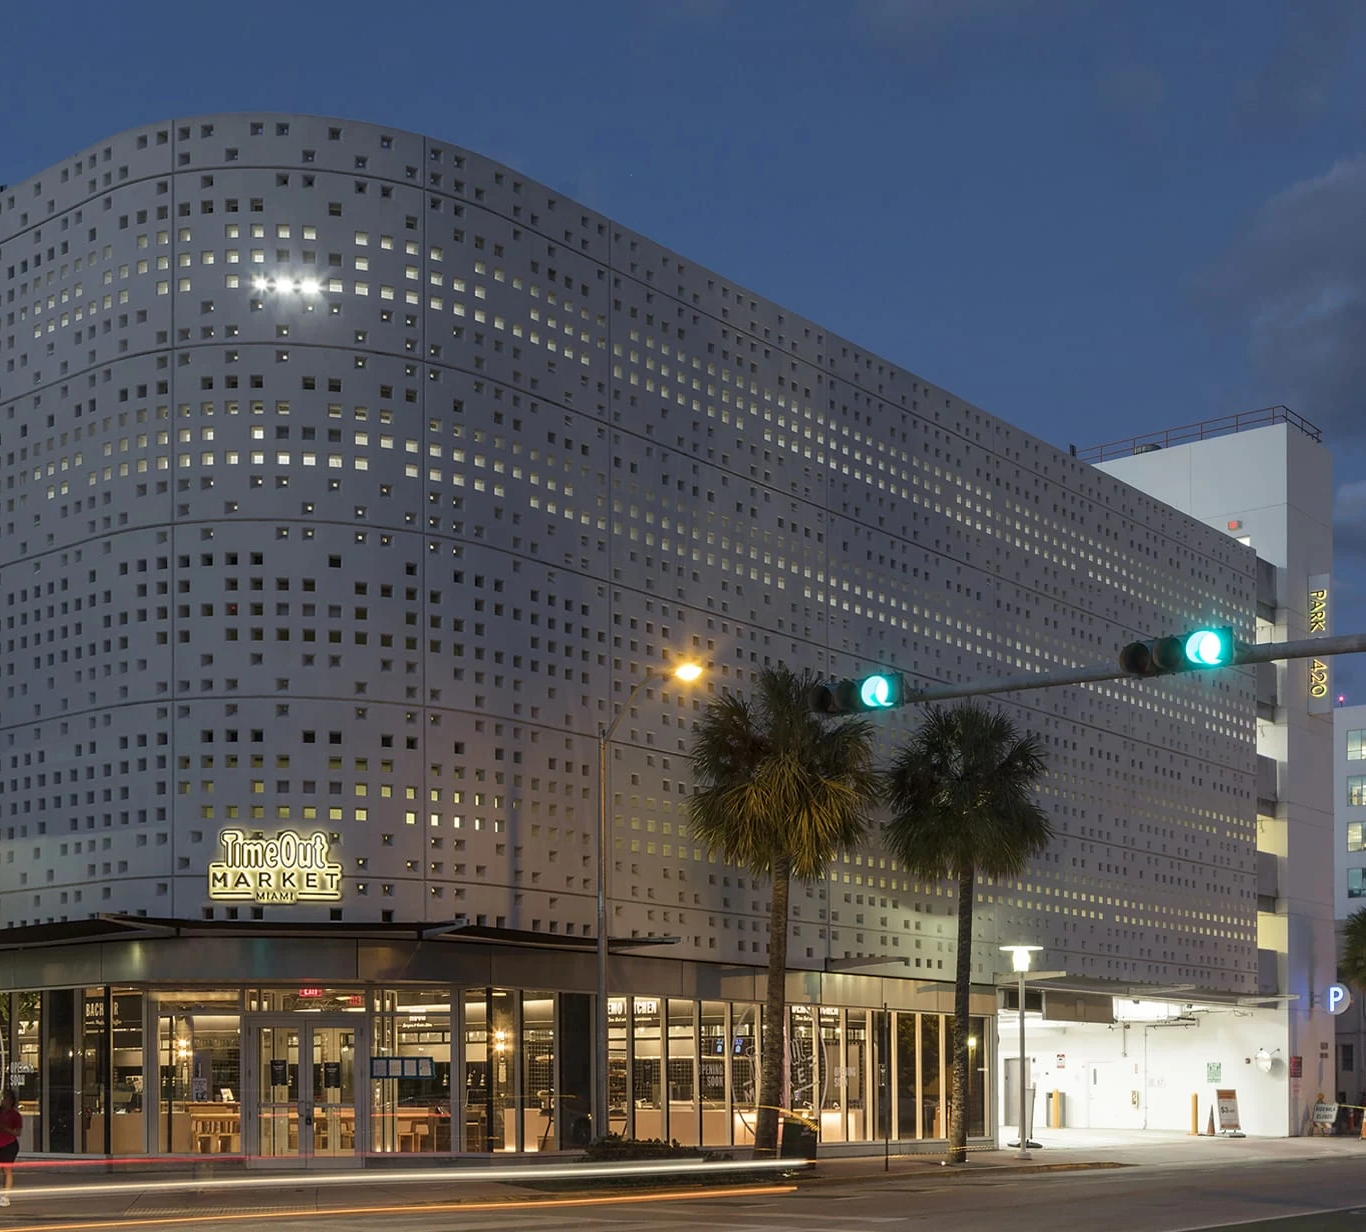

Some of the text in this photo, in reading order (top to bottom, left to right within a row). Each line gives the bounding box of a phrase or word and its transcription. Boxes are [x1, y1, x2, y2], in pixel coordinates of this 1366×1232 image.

[1310, 589, 1327, 698] PARK 420
[212, 872, 339, 888] MARKET
[256, 892, 294, 901] MIAMI
[1329, 986, 1344, 1012] P
[85, 1002, 119, 1016] BACHR
[607, 1001, 623, 1015] EMO
